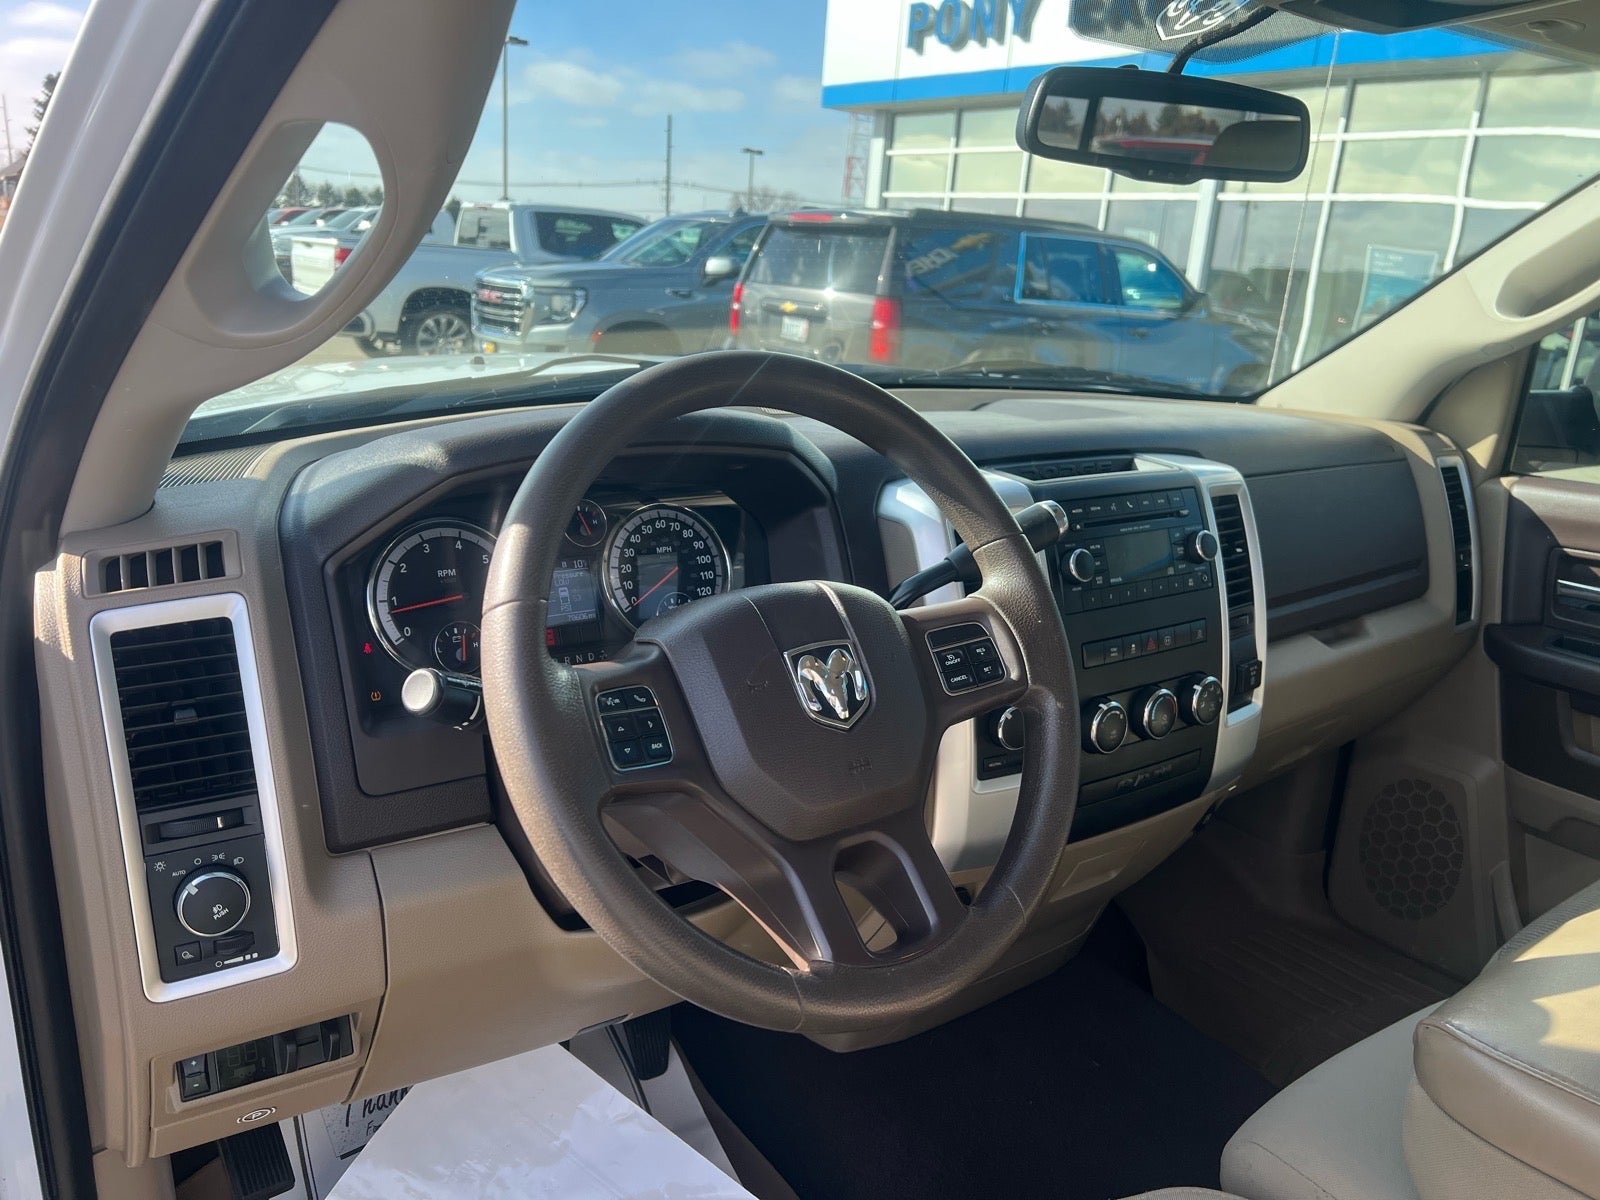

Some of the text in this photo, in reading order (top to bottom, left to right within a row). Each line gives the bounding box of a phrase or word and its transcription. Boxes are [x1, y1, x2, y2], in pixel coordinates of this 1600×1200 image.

[906, 0, 1037, 53] PONY
[655, 520, 666, 529] 60
[669, 522, 680, 532] 70
[641, 525, 653, 535] 50
[682, 529, 694, 538] 80
[630, 534, 641, 543] 40
[423, 543, 430, 553] 3
[455, 540, 462, 550] 4
[656, 545, 672, 554] MPH
[693, 542, 704, 551] 90
[624, 548, 635, 557] 30
[482, 554, 489, 564] 5
[696, 555, 711, 564] 100
[400, 563, 407, 573] 2
[437, 568, 456, 578] RPM
[620, 564, 632, 573] 20
[700, 571, 714, 580] 110
[622, 580, 633, 590] 10
[696, 587, 712, 596] 120
[391, 596, 398, 606] 1
[404, 626, 411, 637] 0
[564, 652, 595, 665] R N D
[950, 674, 968, 683] CANCEL
[172, 869, 186, 877] AUTO
[213, 907, 229, 920] PUSH
